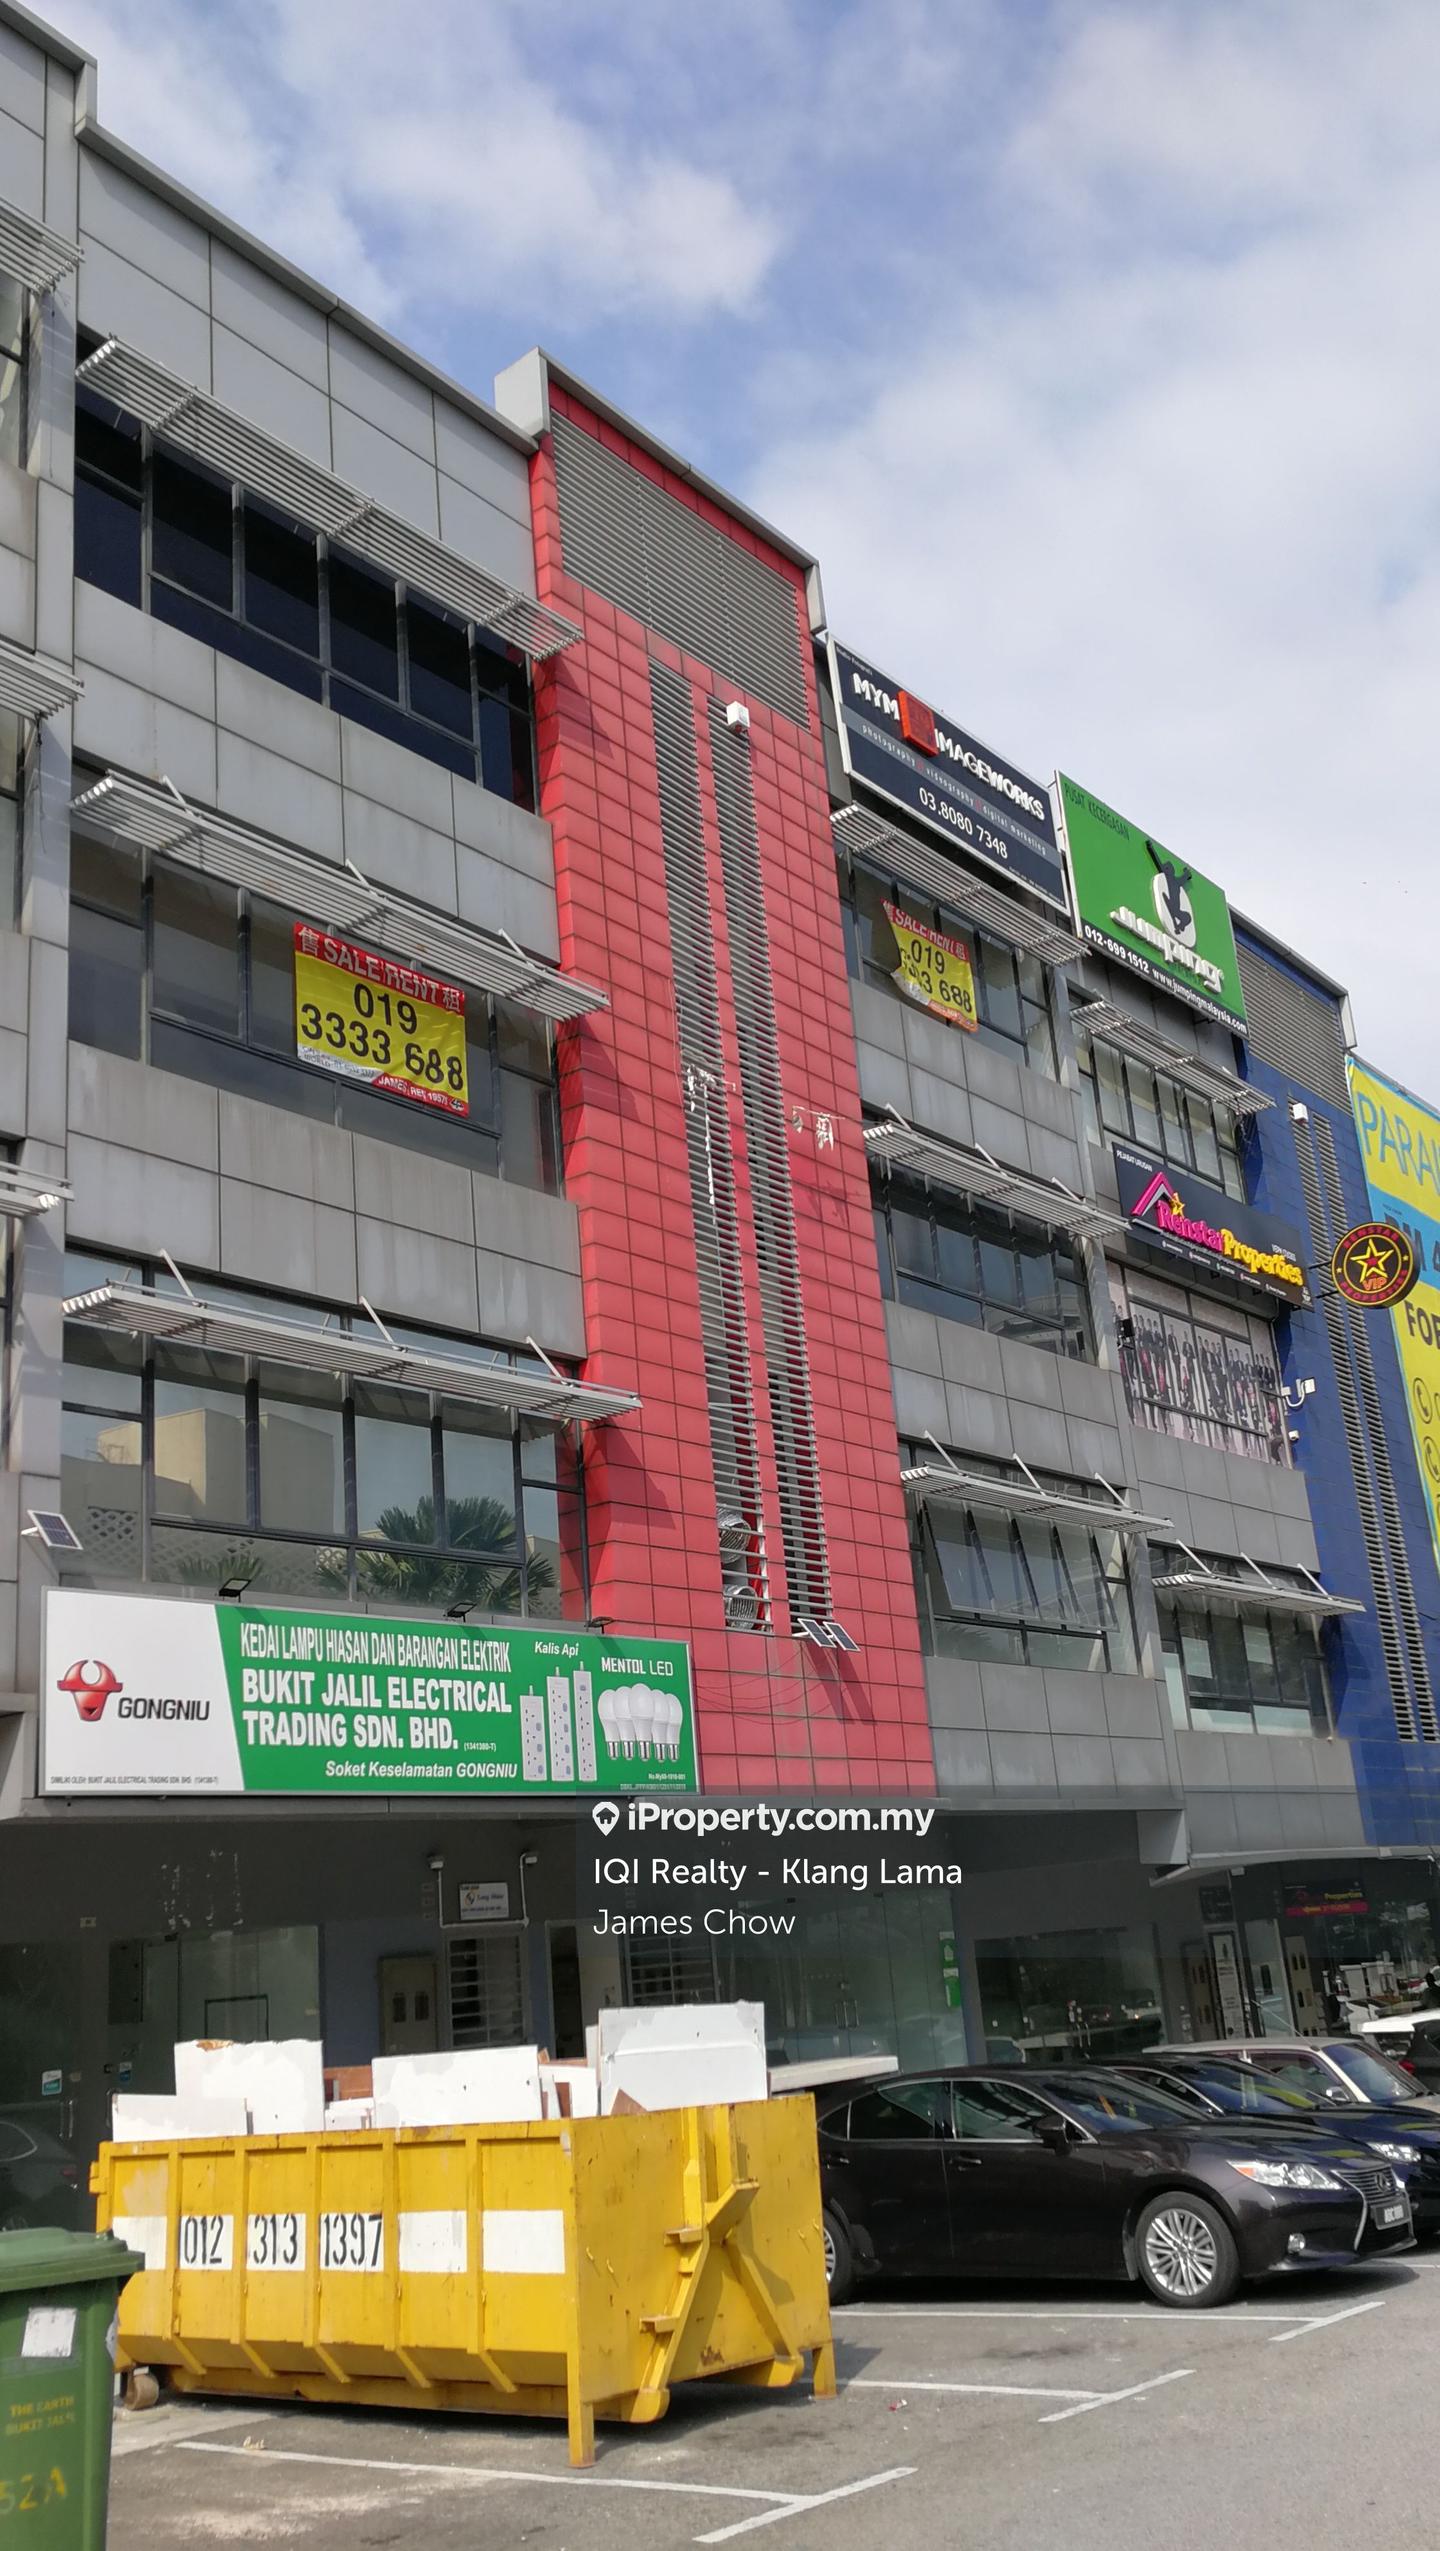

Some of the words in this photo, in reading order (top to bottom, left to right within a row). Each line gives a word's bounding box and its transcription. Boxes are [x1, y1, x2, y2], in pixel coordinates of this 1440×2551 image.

[853, 672, 900, 721] MYM
[934, 728, 1045, 821] IMAGEWORKS
[862, 724, 916, 767] photography
[976, 824, 1008, 859] 7348
[323, 938, 380, 983] SALE
[384, 963, 439, 1004] RENT
[911, 939, 945, 975] 019
[353, 983, 417, 1034] 019
[939, 979, 972, 1013] 688
[301, 1003, 391, 1065] 3333
[404, 1042, 464, 1091] 688
[1362, 1276, 1388, 1291] VIP
[240, 1622, 280, 1659] KEDAI
[281, 1625, 323, 1662] LAMPU
[326, 1628, 369, 1665] HIASAN
[371, 1632, 395, 1666] DAN
[397, 1634, 459, 1670] BARANGAN
[460, 1638, 512, 1673] ELEKTRIK
[534, 1641, 560, 1655] Kalis
[561, 1642, 579, 1658] Api
[601, 1656, 646, 1675] MENTOL
[649, 1660, 674, 1676] LED
[117, 1697, 210, 1721] GONGNIU
[242, 1668, 315, 1705] BUKIT
[321, 1673, 382, 1708] JALIL
[387, 1676, 512, 1713] ELECTRICAL
[242, 1710, 347, 1748] TRADING
[353, 1713, 404, 1749] SDN.
[409, 1716, 459, 1750] BHD.
[325, 1760, 366, 1776] Soket
[368, 1761, 453, 1777] Keselamatan
[456, 1763, 518, 1778] GONGNIU
[183, 2214, 223, 2265] 012
[252, 2213, 300, 2265] 313
[323, 2213, 384, 2267] 1397
